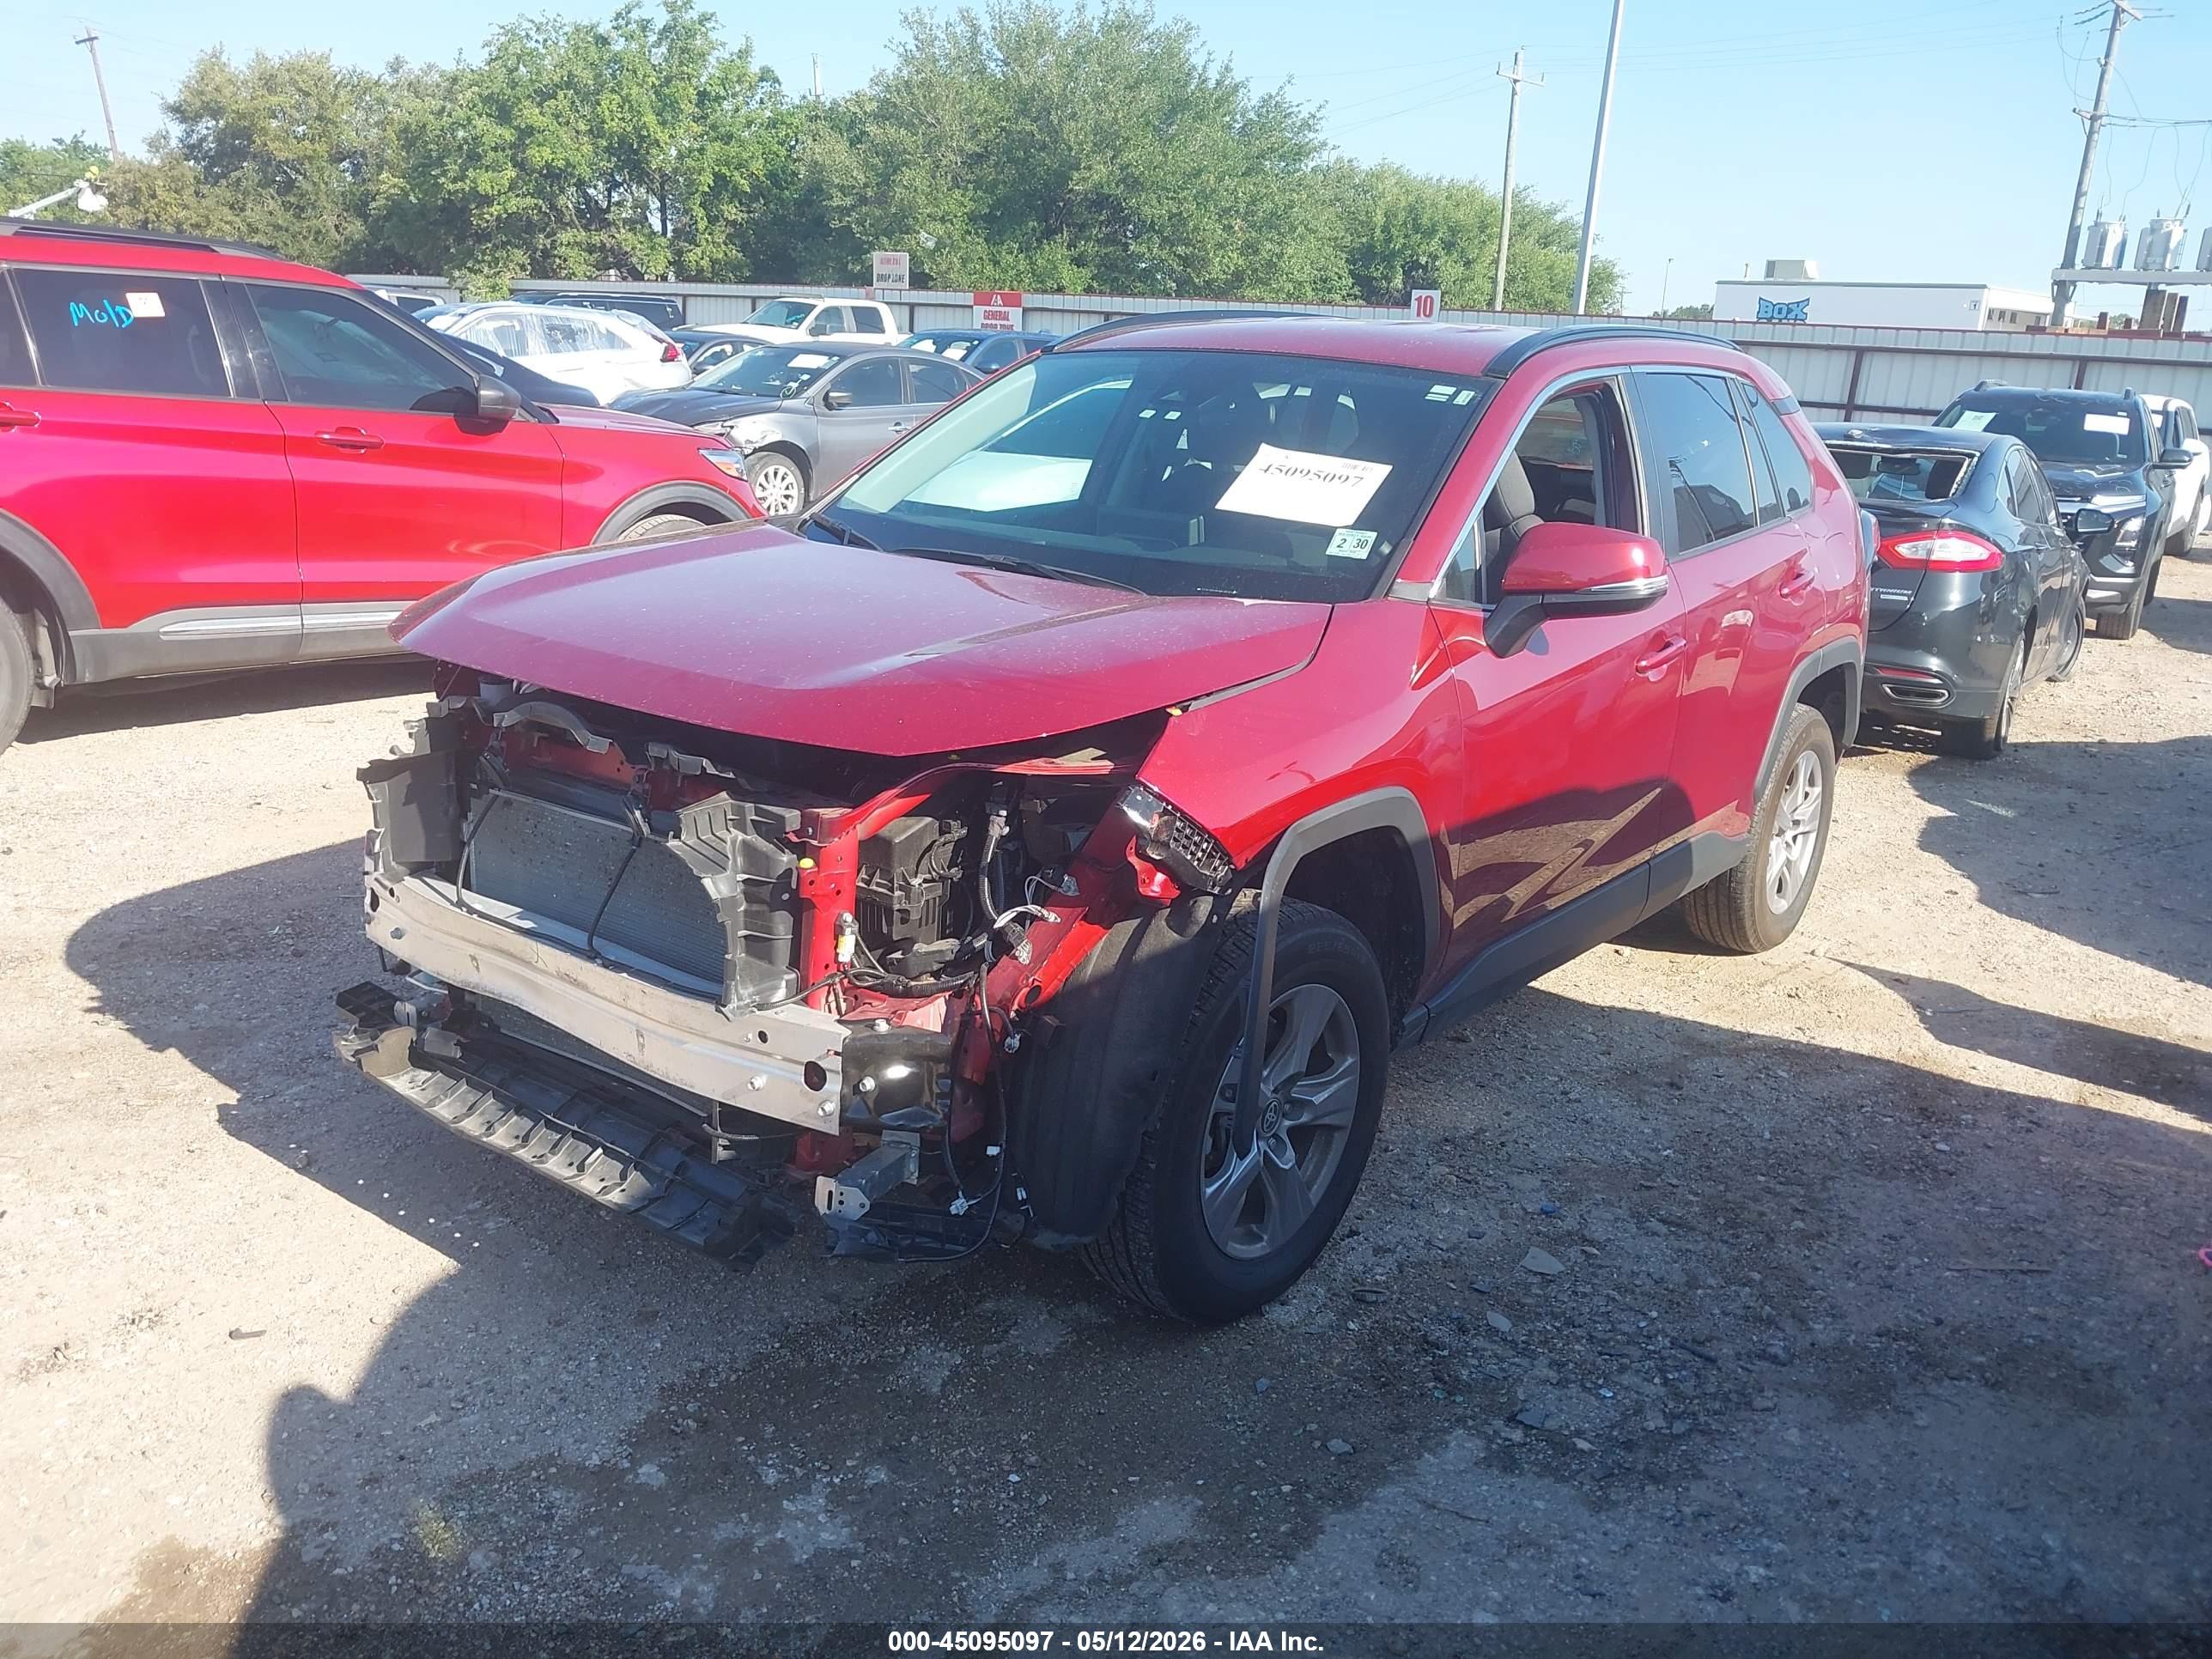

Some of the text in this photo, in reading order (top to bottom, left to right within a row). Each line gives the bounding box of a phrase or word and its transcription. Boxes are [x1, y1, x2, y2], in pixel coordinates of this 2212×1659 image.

[877, 272, 905, 283] DROP ZONE
[983, 309, 1010, 321] GENERAL
[1414, 295, 1435, 318] 10
[1756, 295, 1810, 319] BOX
[1259, 463, 1364, 488] 45095097
[1336, 538, 1369, 550] 2 30
